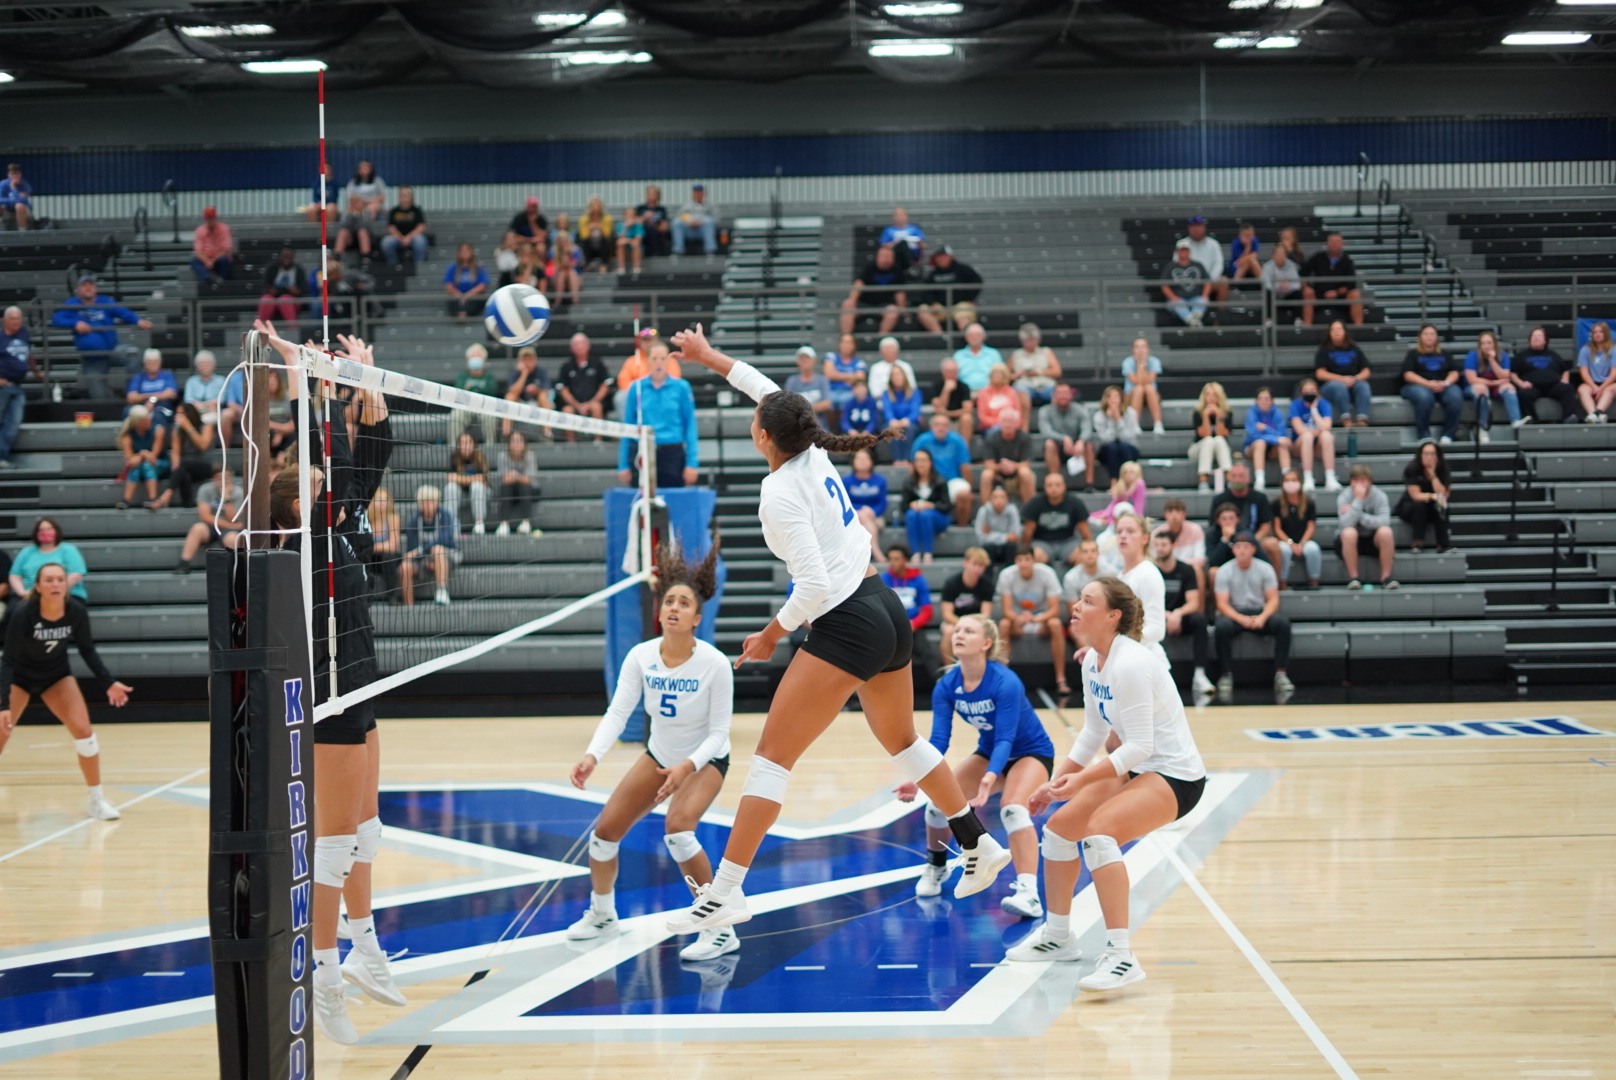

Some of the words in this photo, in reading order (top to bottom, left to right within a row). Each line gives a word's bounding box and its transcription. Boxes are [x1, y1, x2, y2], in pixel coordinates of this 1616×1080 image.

[824, 476, 855, 527] 2
[45, 640, 58, 653] 7
[645, 675, 699, 692] KIRKWOOD
[660, 694, 678, 718] 5
[284, 678, 310, 1080] KIRKWOOD
